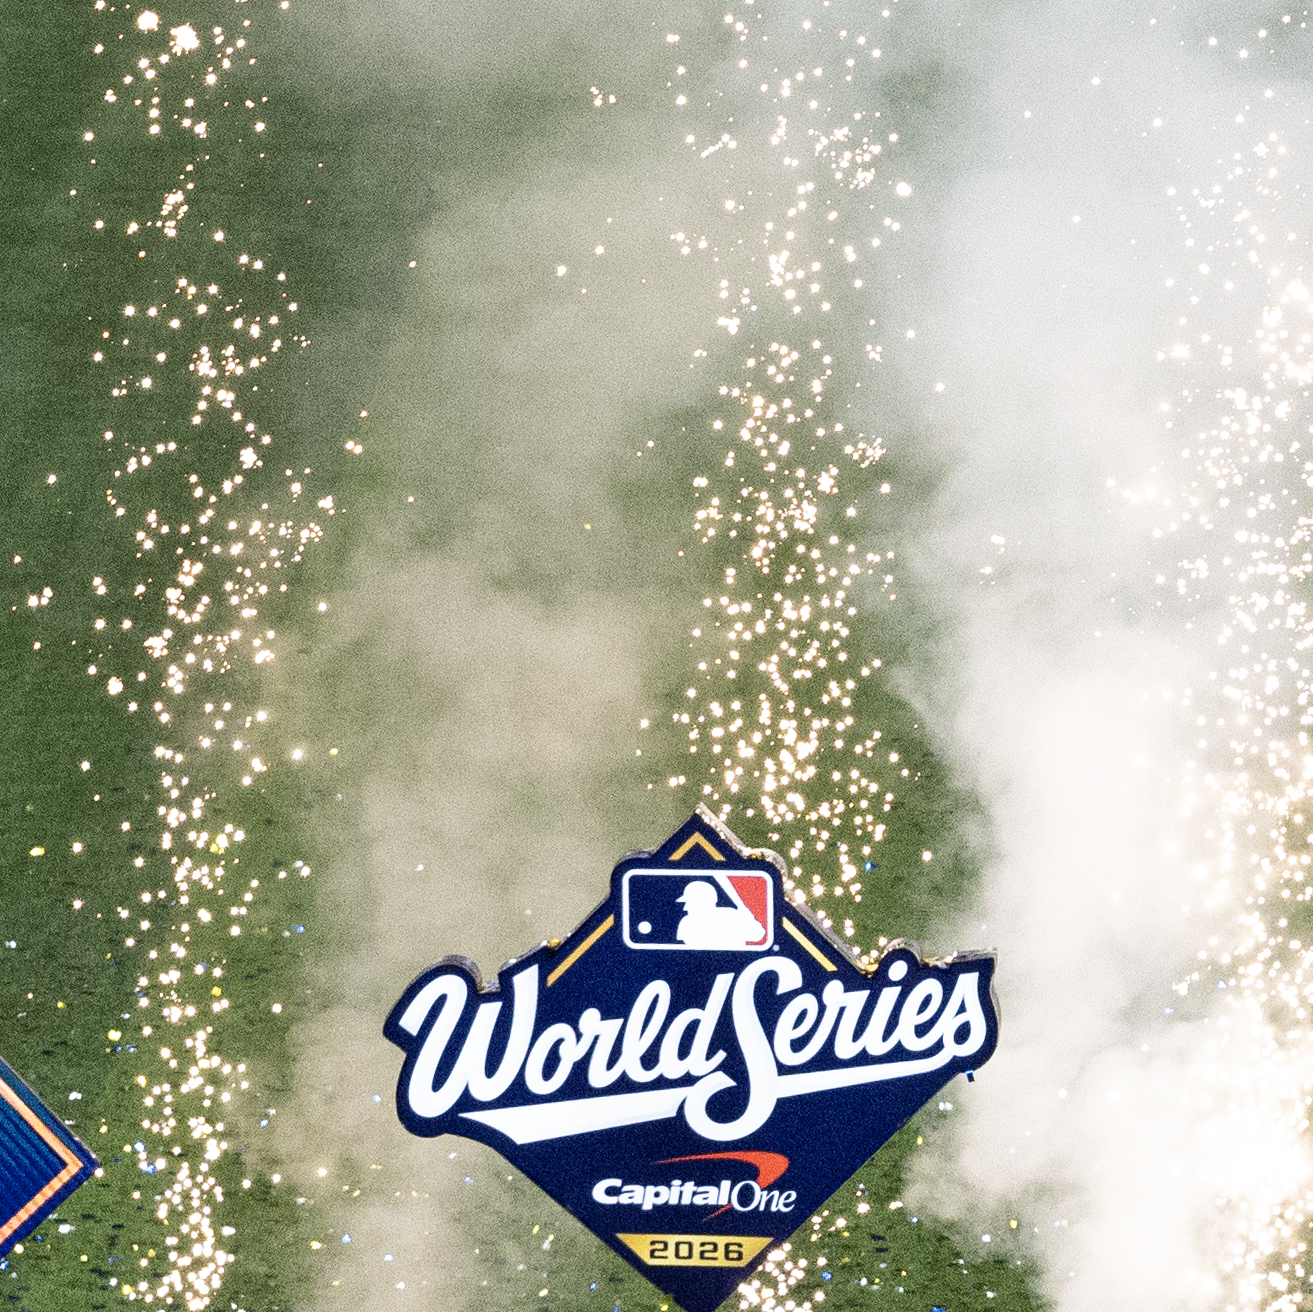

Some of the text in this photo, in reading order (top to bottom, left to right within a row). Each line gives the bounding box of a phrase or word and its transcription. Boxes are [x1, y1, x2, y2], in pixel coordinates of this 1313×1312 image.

[399, 956, 987, 1142] World Series
[649, 1241, 743, 1262] 2026
